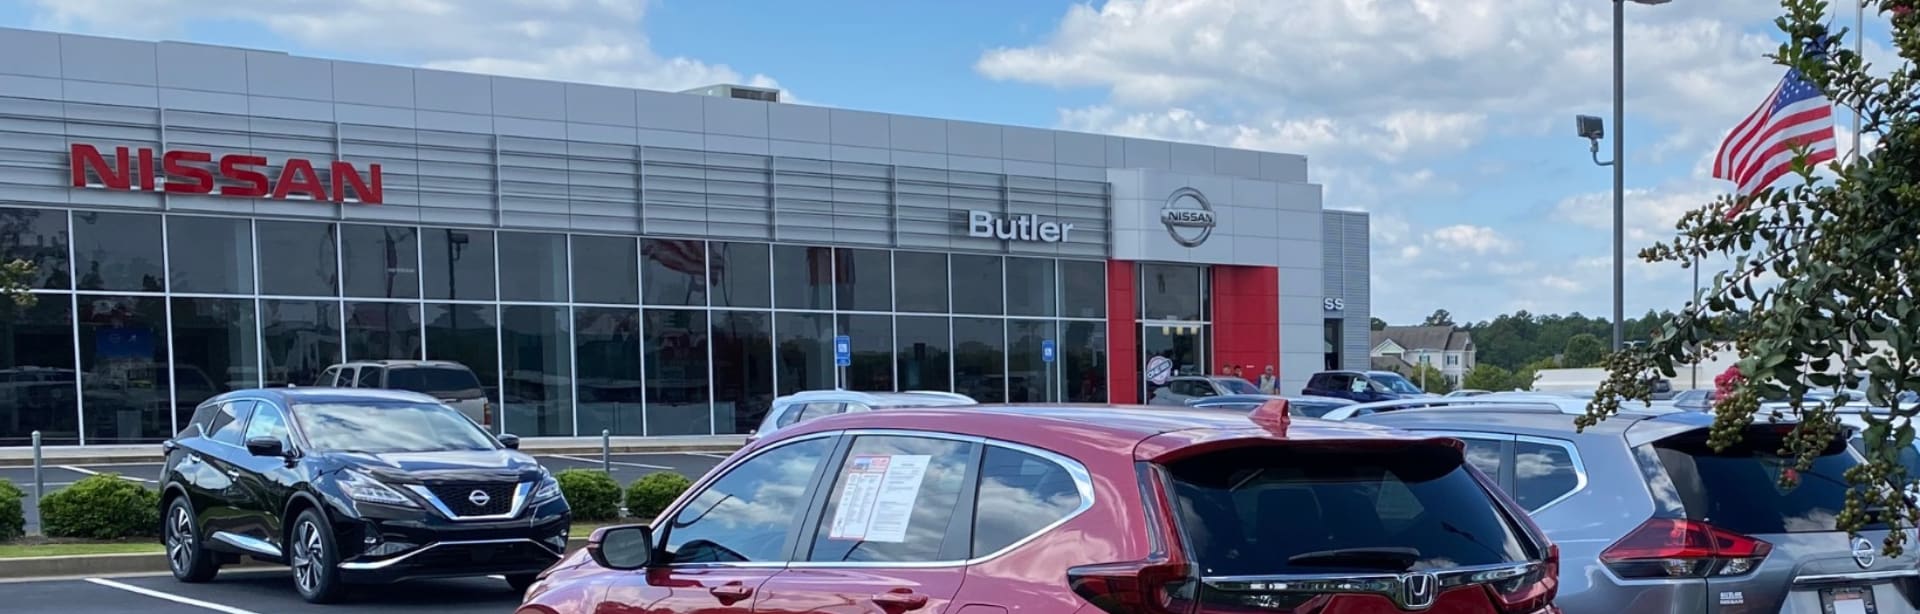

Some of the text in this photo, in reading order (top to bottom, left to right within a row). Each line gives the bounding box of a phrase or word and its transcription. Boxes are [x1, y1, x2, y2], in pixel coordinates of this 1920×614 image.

[71, 143, 383, 204] NISSAN
[969, 210, 1074, 242] Butler
[1168, 211, 1213, 223] NISSAN
